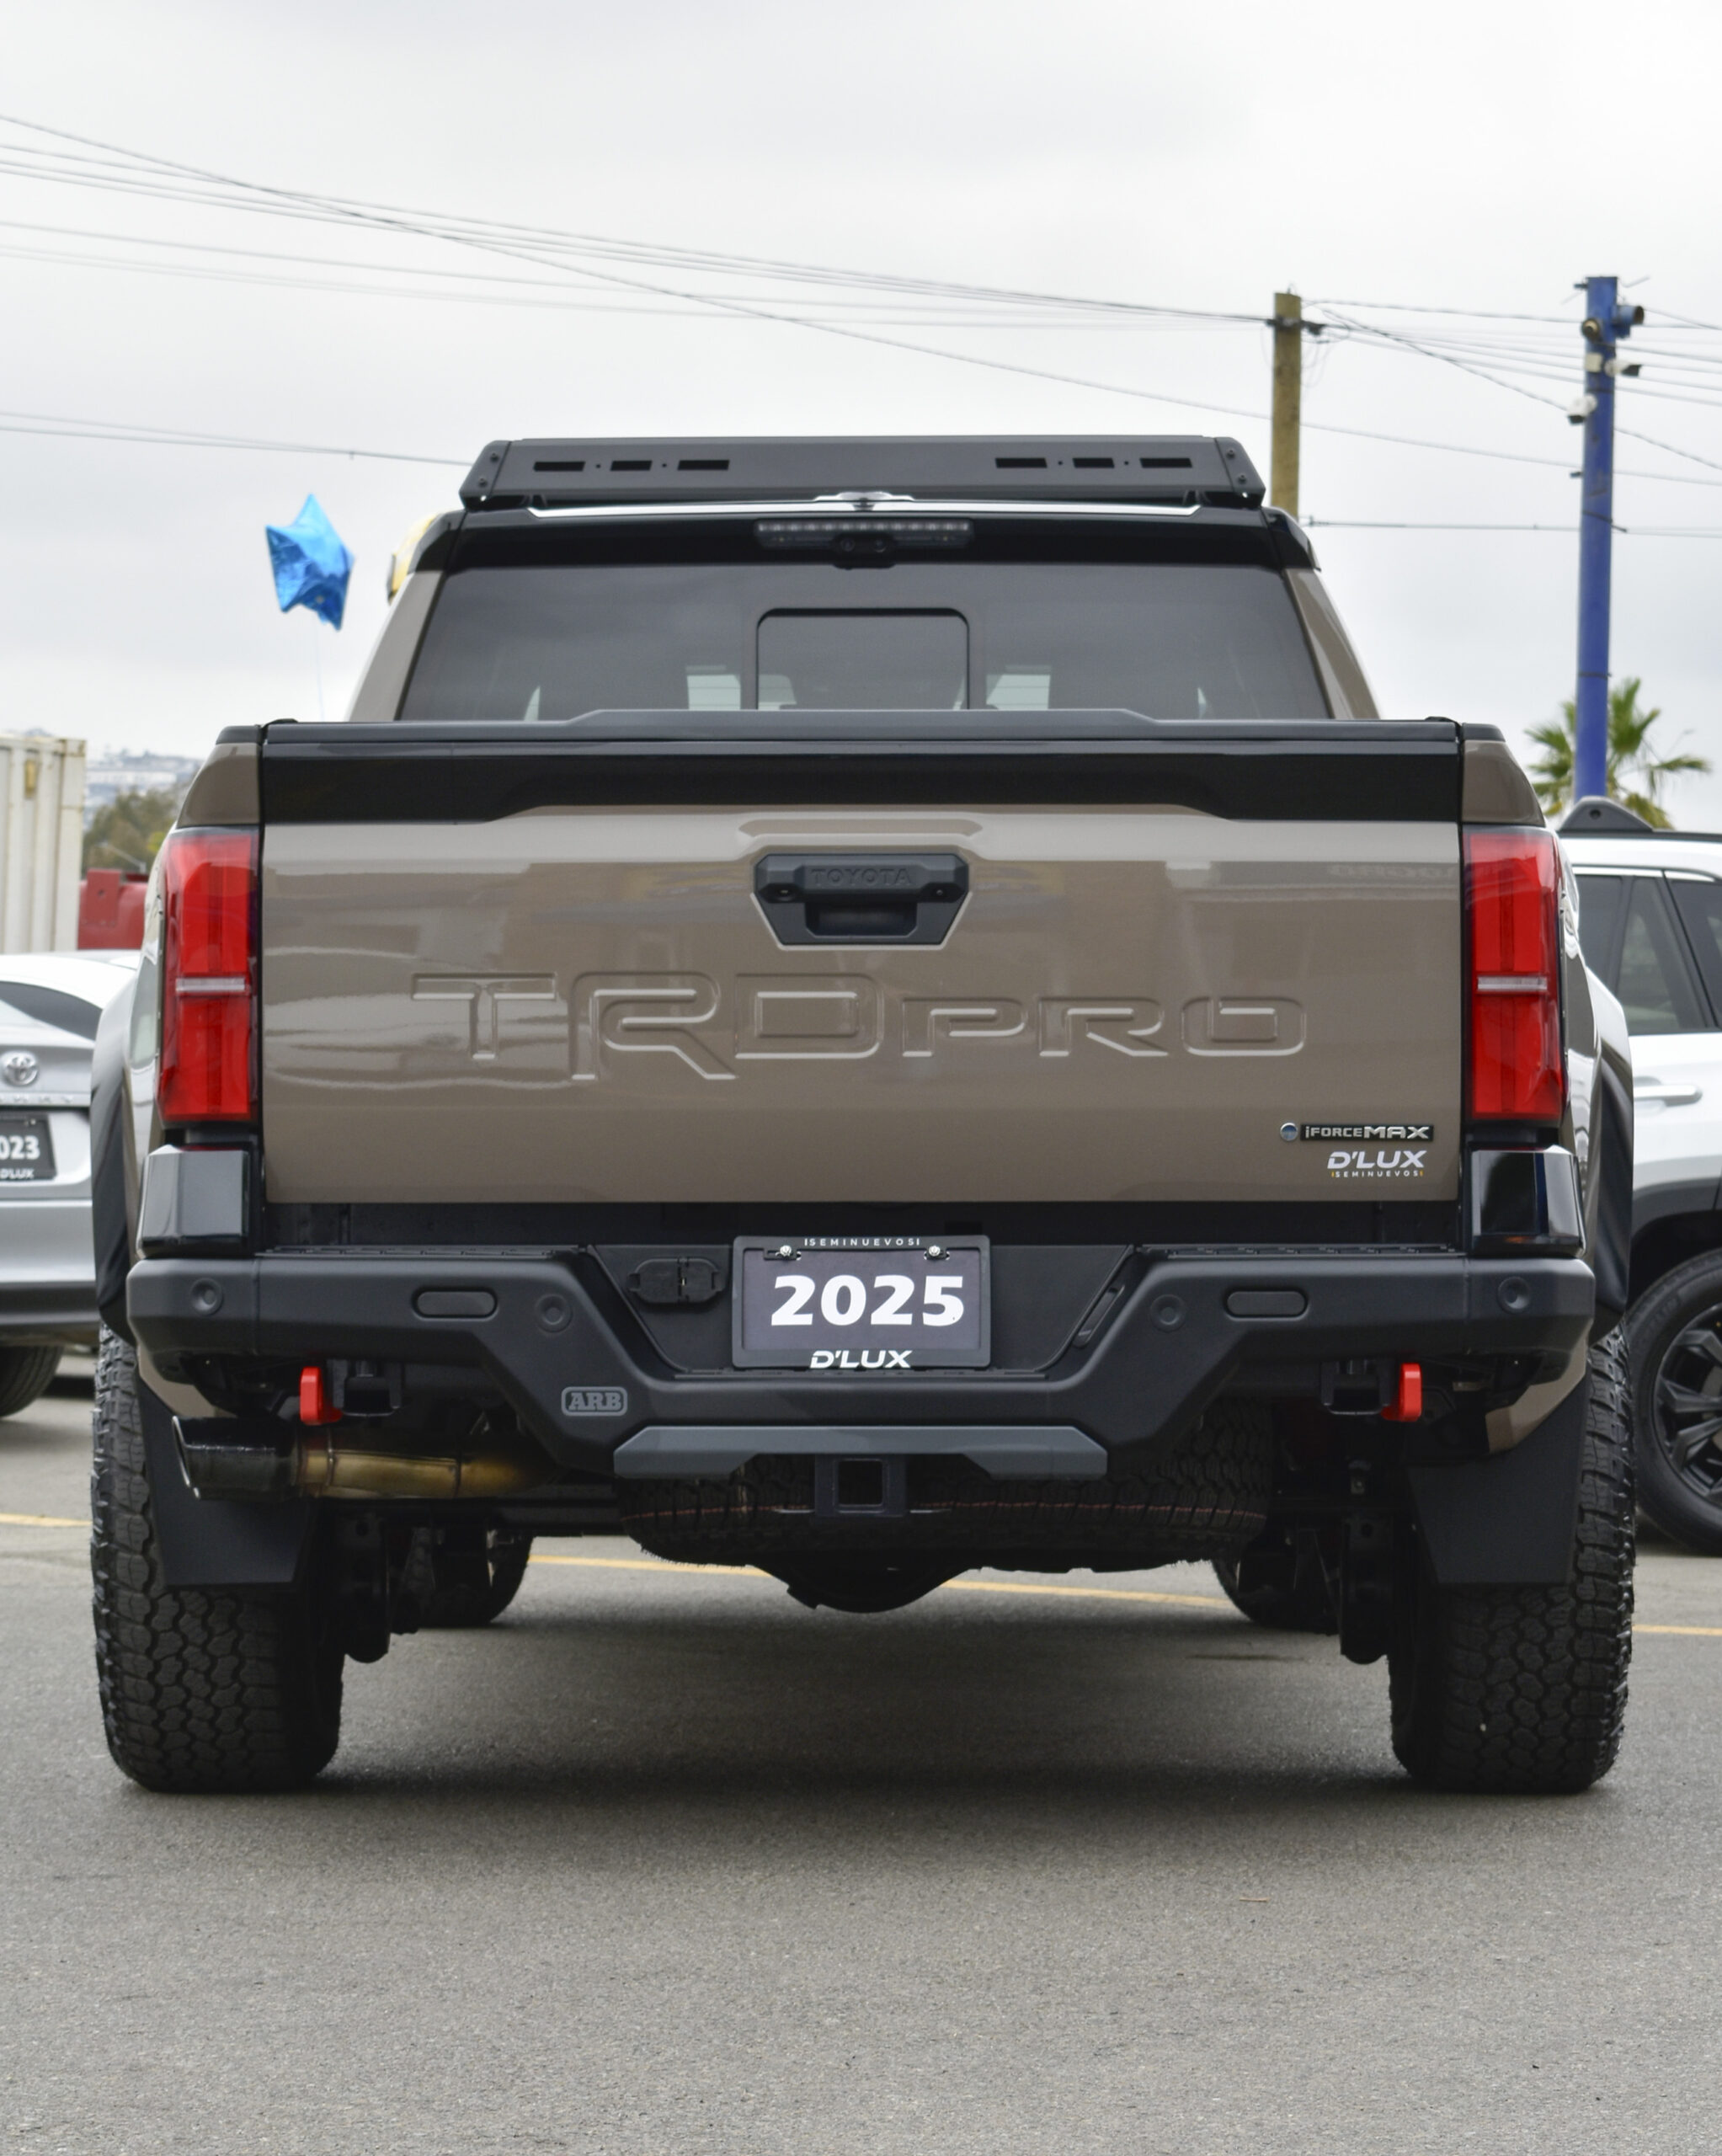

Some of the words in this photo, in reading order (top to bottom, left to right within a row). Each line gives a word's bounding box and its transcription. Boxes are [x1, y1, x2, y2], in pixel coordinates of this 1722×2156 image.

[811, 868, 912, 884] TOYOTA
[411, 971, 884, 1081] TRD
[902, 996, 1307, 1057] PRO
[1327, 1150, 1427, 1169] D'LUX
[770, 1274, 965, 1326] 2025
[809, 1350, 914, 1369] D'LUX
[568, 1392, 621, 1411] ARB
